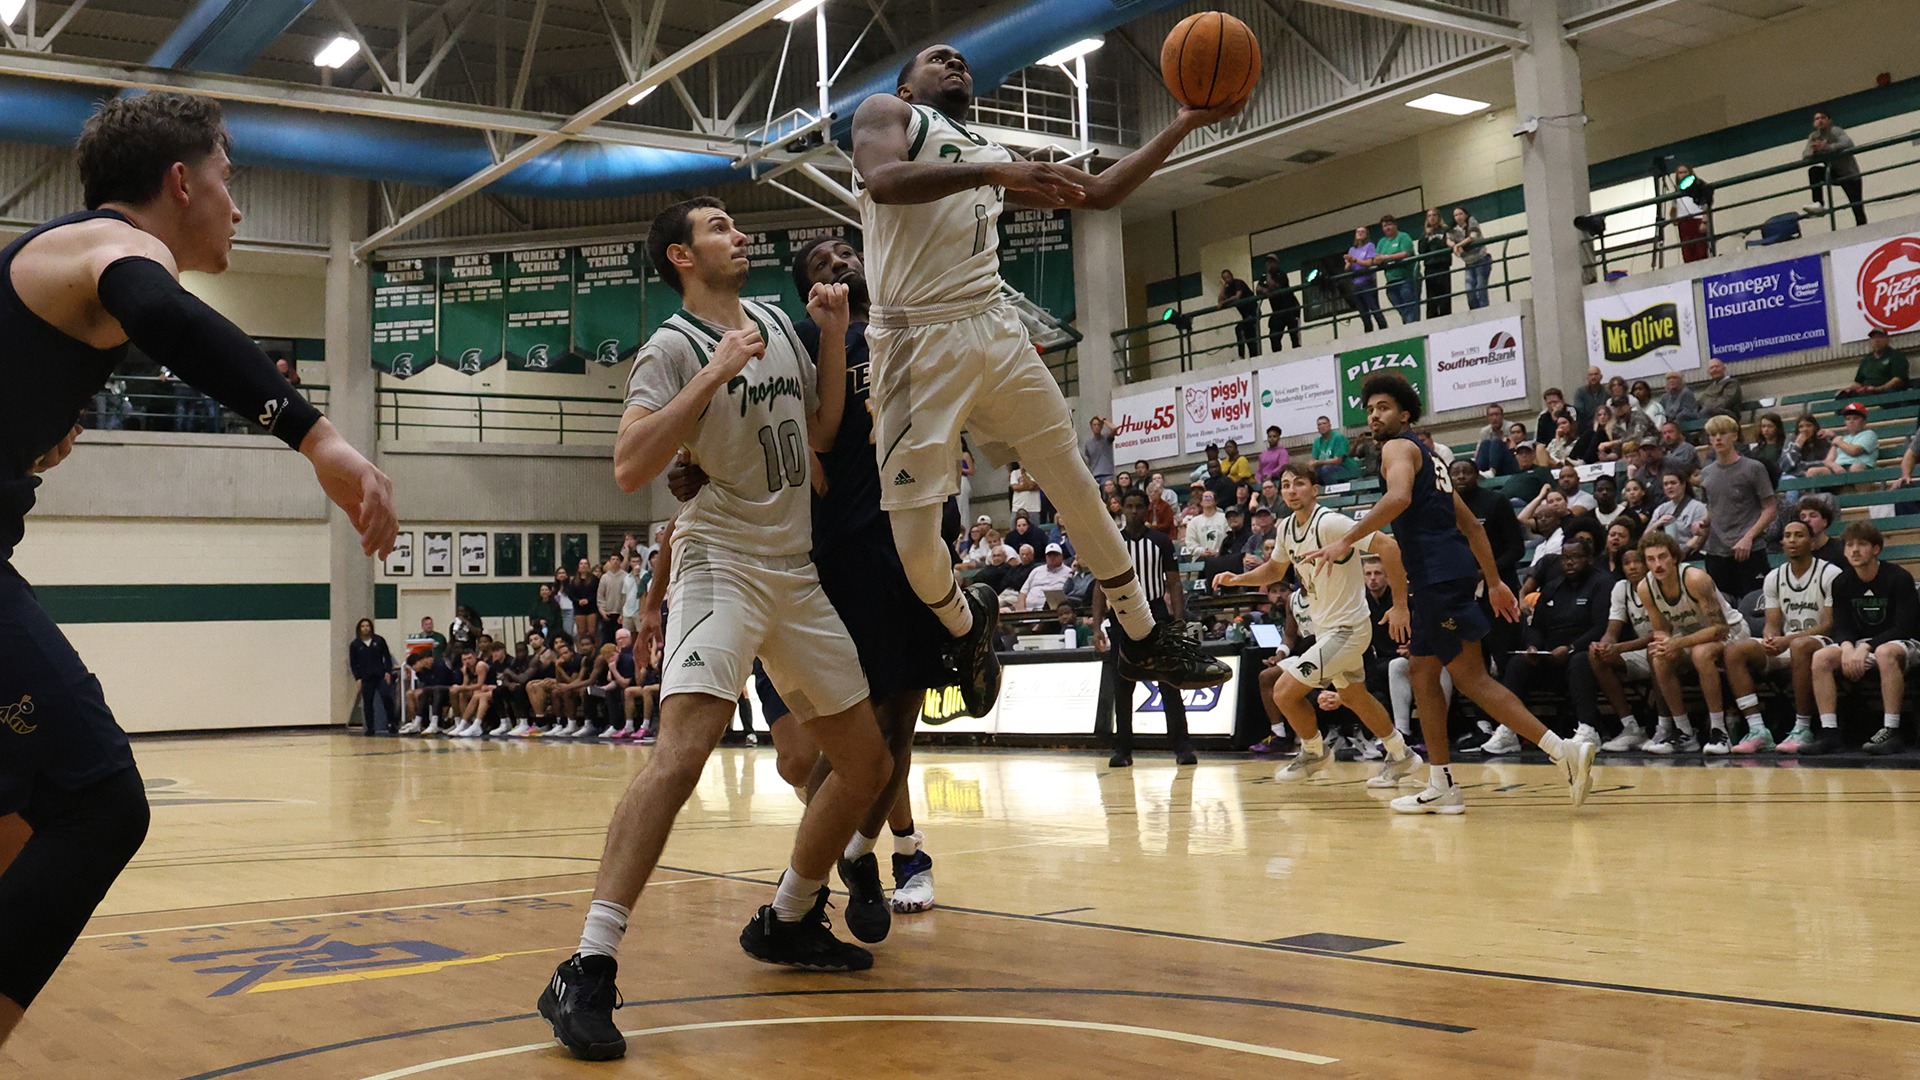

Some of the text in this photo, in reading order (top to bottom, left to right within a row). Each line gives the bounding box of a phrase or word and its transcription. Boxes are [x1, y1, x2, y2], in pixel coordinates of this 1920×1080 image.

[975, 204, 989, 256] 1
[1005, 219, 1065, 235] WRESTLING
[512, 248, 566, 263] WOMEN'S
[580, 243, 635, 258] WOMEN'S
[387, 259, 422, 271] MEN'S
[454, 254, 490, 267] MEN'S
[519, 260, 560, 273] TENNIS
[587, 255, 629, 268] TENNIS
[384, 270, 424, 283] TENNIS
[452, 265, 492, 278] TENNIS
[1707, 273, 1781, 299] Kornegay
[1873, 274, 1920, 306] Pizza
[1708, 294, 1785, 320] Insurance
[1883, 288, 1920, 317] Hut
[1606, 315, 1674, 354] Mt. Olive
[1712, 328, 1826, 355] kornegayinsurance.com
[1347, 353, 1418, 381] PIZZA
[1211, 377, 1248, 402] piggly
[1501, 375, 1517, 388] You
[727, 375, 802, 418] Trojans
[1211, 399, 1251, 422] wiggly
[1115, 440, 1139, 449] BURGERS
[1140, 436, 1161, 445] SHAKES
[758, 418, 806, 493] 10
[1783, 598, 1819, 615] Trojans
[682, 660, 705, 668] adidas
